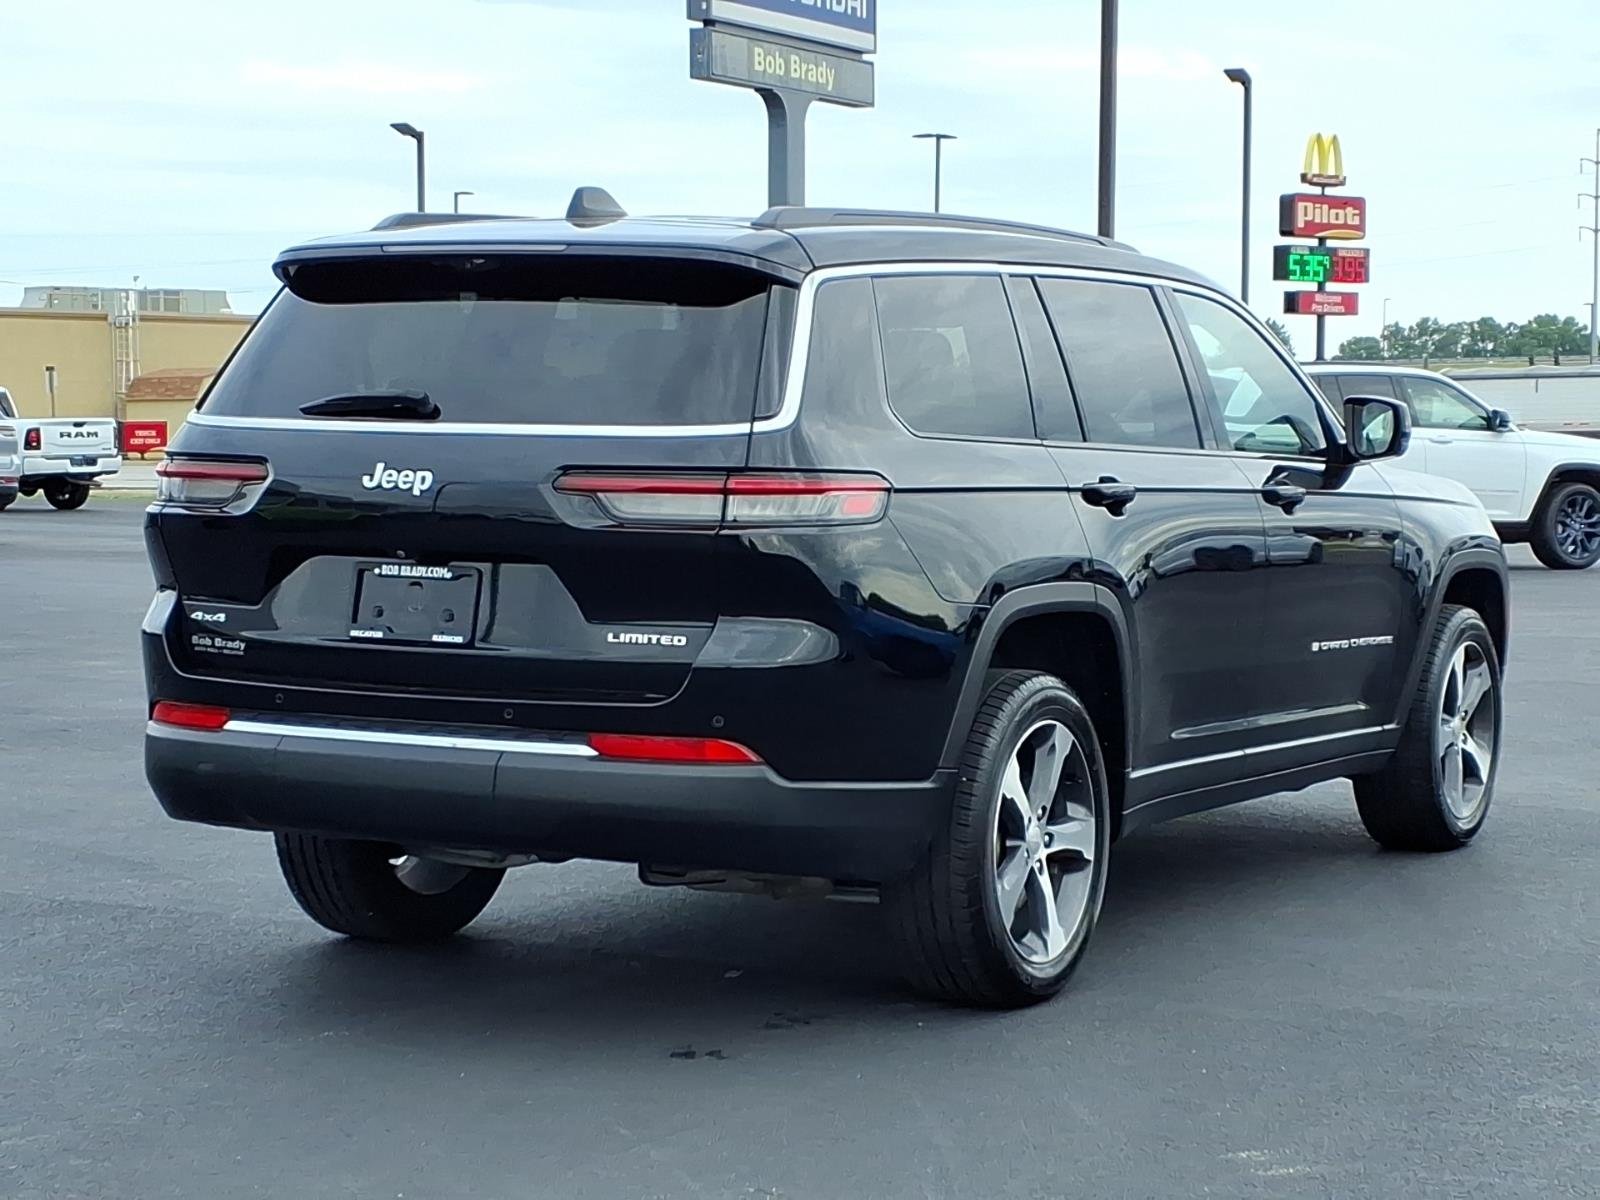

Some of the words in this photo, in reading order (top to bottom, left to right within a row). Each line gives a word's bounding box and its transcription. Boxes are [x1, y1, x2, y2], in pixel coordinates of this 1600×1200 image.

[753, 47, 785, 76] Bob
[790, 54, 835, 91] Brady
[1297, 201, 1361, 228] Pilot
[59, 431, 99, 439] RAM
[362, 462, 433, 496] Jeep
[381, 564, 399, 576] BOB
[190, 611, 226, 622] 4x4
[191, 635, 212, 646] Bob
[214, 637, 246, 651] Brady
[607, 632, 687, 646] LIMITED
